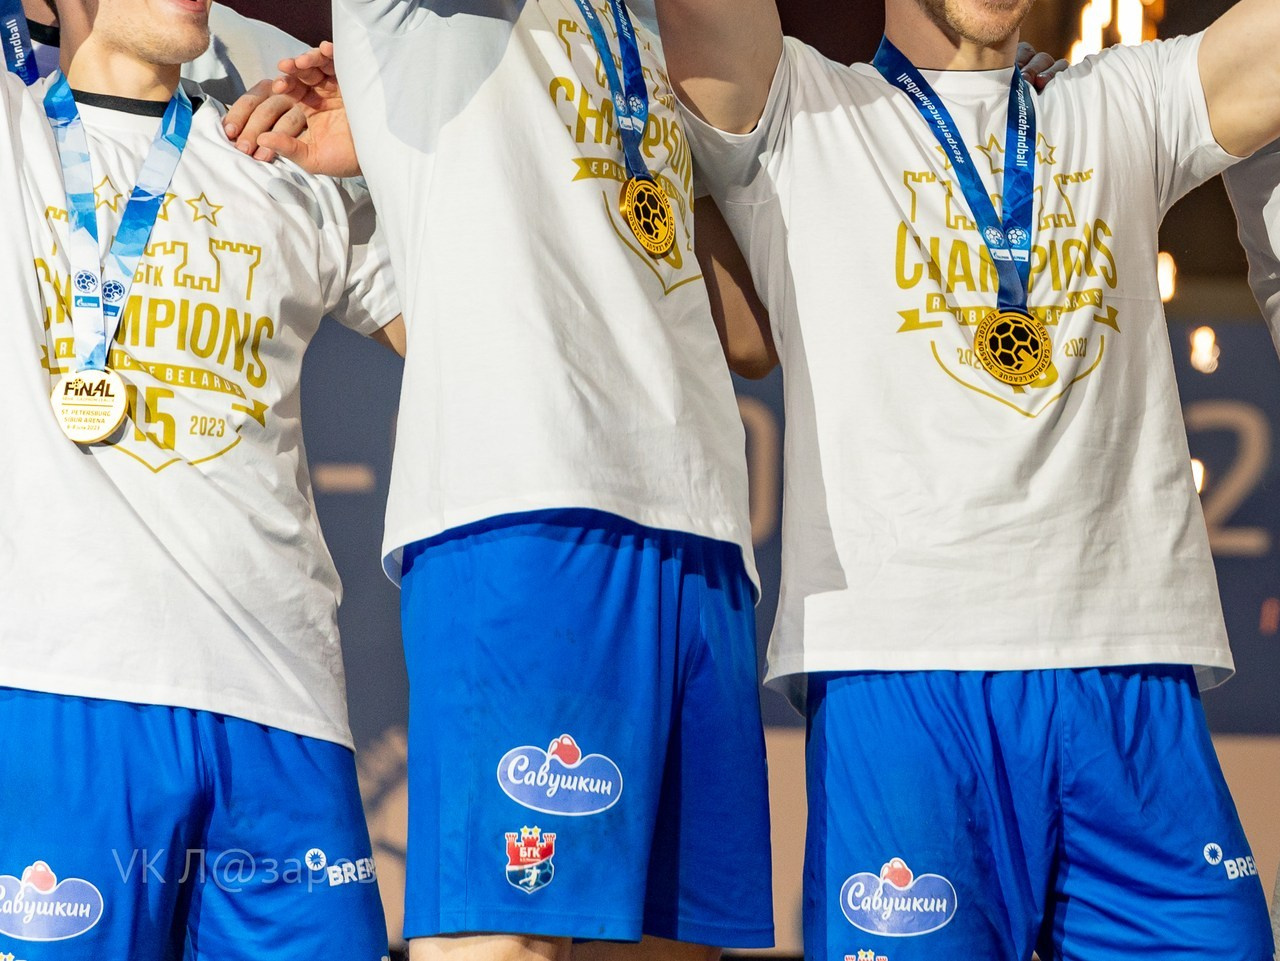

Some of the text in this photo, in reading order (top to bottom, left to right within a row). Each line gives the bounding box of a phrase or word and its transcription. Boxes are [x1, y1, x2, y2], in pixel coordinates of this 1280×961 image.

[896, 72, 964, 164] #experiencehandball
[1046, 291, 1100, 322] BEARUS
[957, 348, 986, 370] 202
[978, 313, 1050, 382] SEHA GAZPROM LEAGUE SEASON 2022/23
[189, 415, 226, 438] 2023
[507, 754, 612, 798] Савушкин
[519, 846, 541, 858] БГК
[327, 857, 376, 887] BREM
[1223, 856, 1257, 880] BRE
[847, 881, 947, 920] Савушкин
